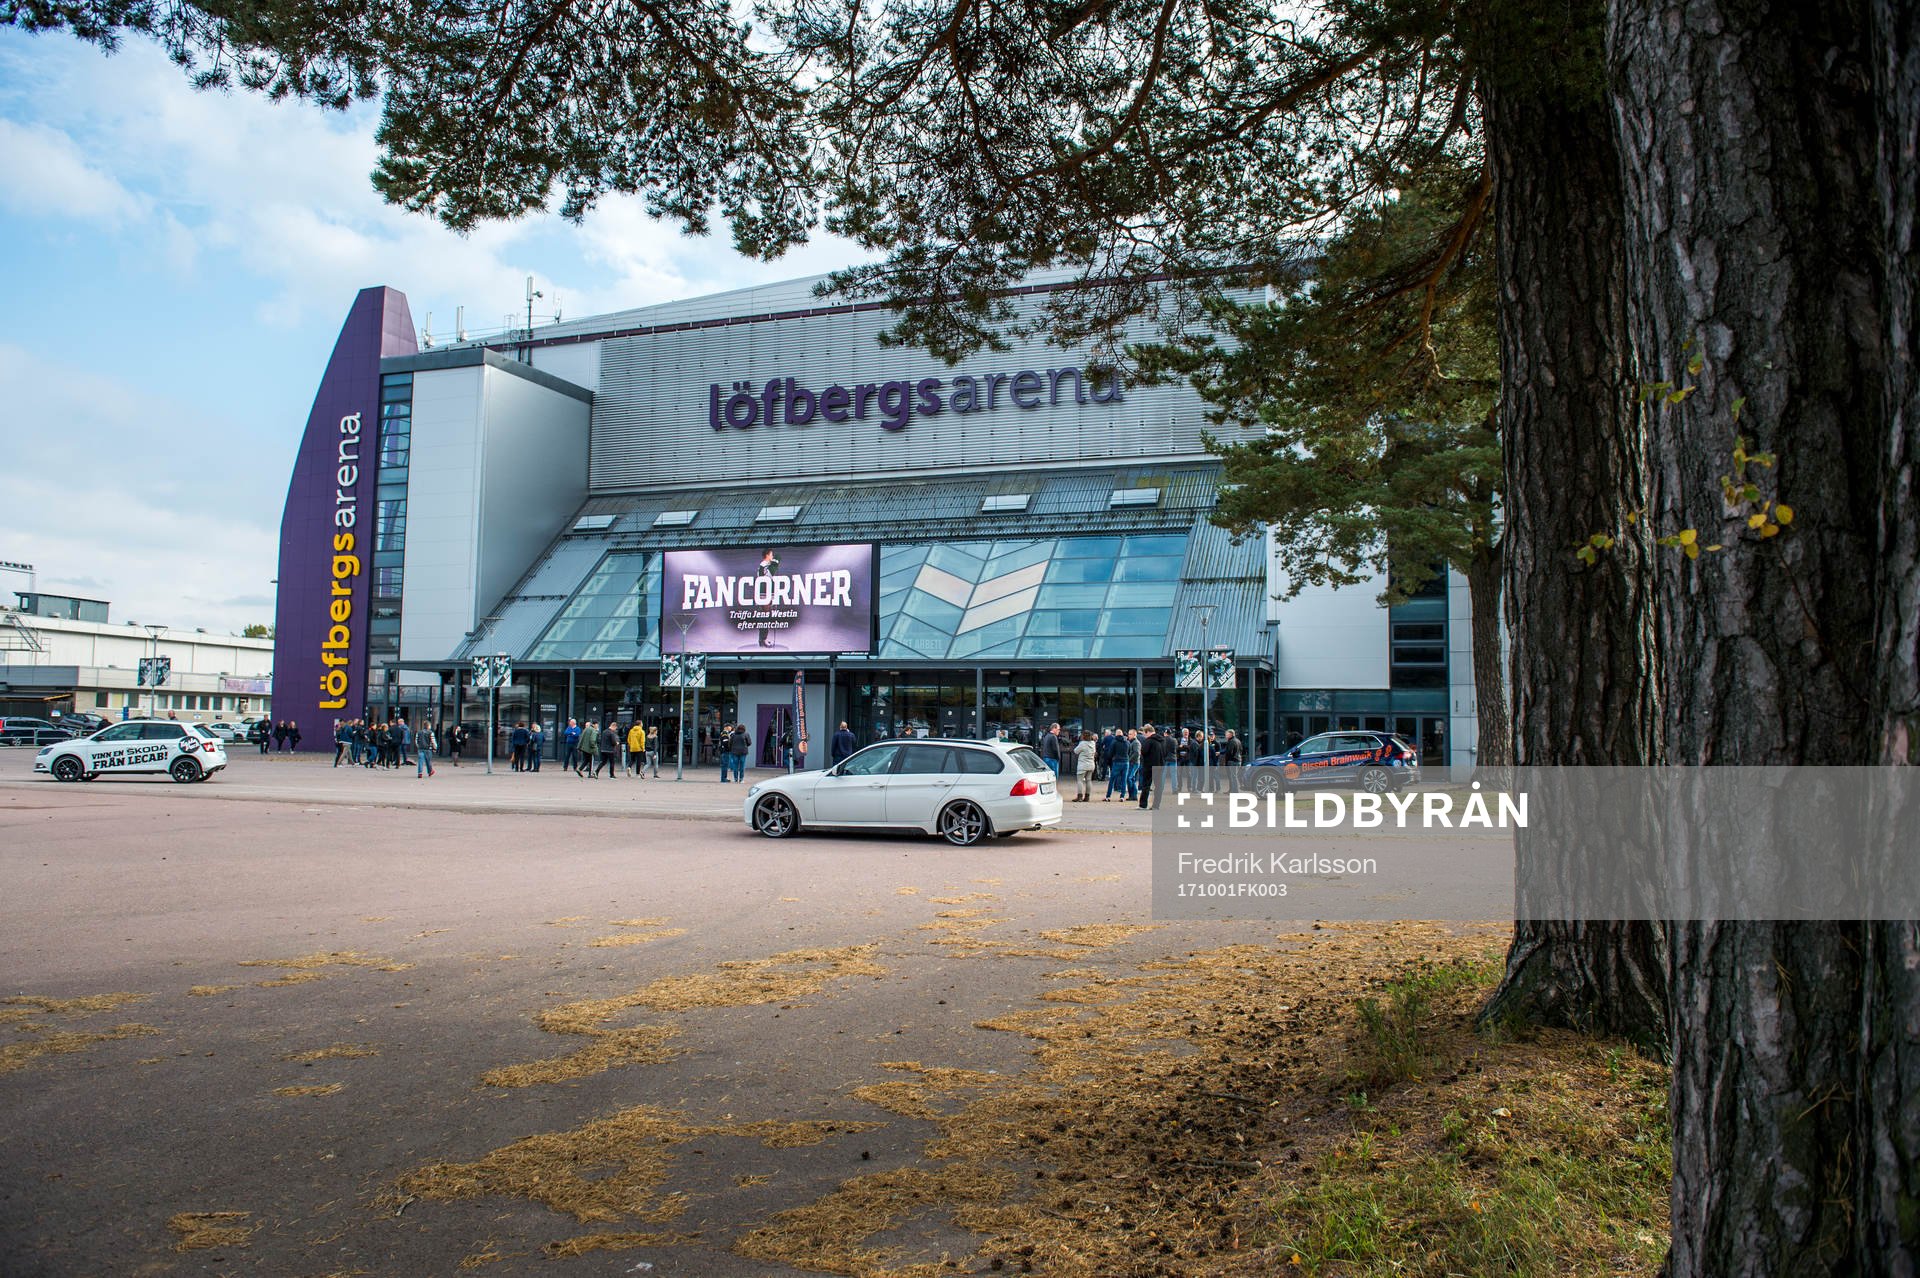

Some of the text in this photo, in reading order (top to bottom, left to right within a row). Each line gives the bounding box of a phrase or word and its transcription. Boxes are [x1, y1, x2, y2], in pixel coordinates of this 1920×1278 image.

[730, 609, 798, 619] Träffa Jens Westin
[737, 620, 789, 630] efter matchen
[92, 751, 112, 760] VINN
[113, 749, 124, 757] EN
[92, 751, 169, 770] FRÅN LECAB!
[1301, 759, 1329, 772] Bissen
